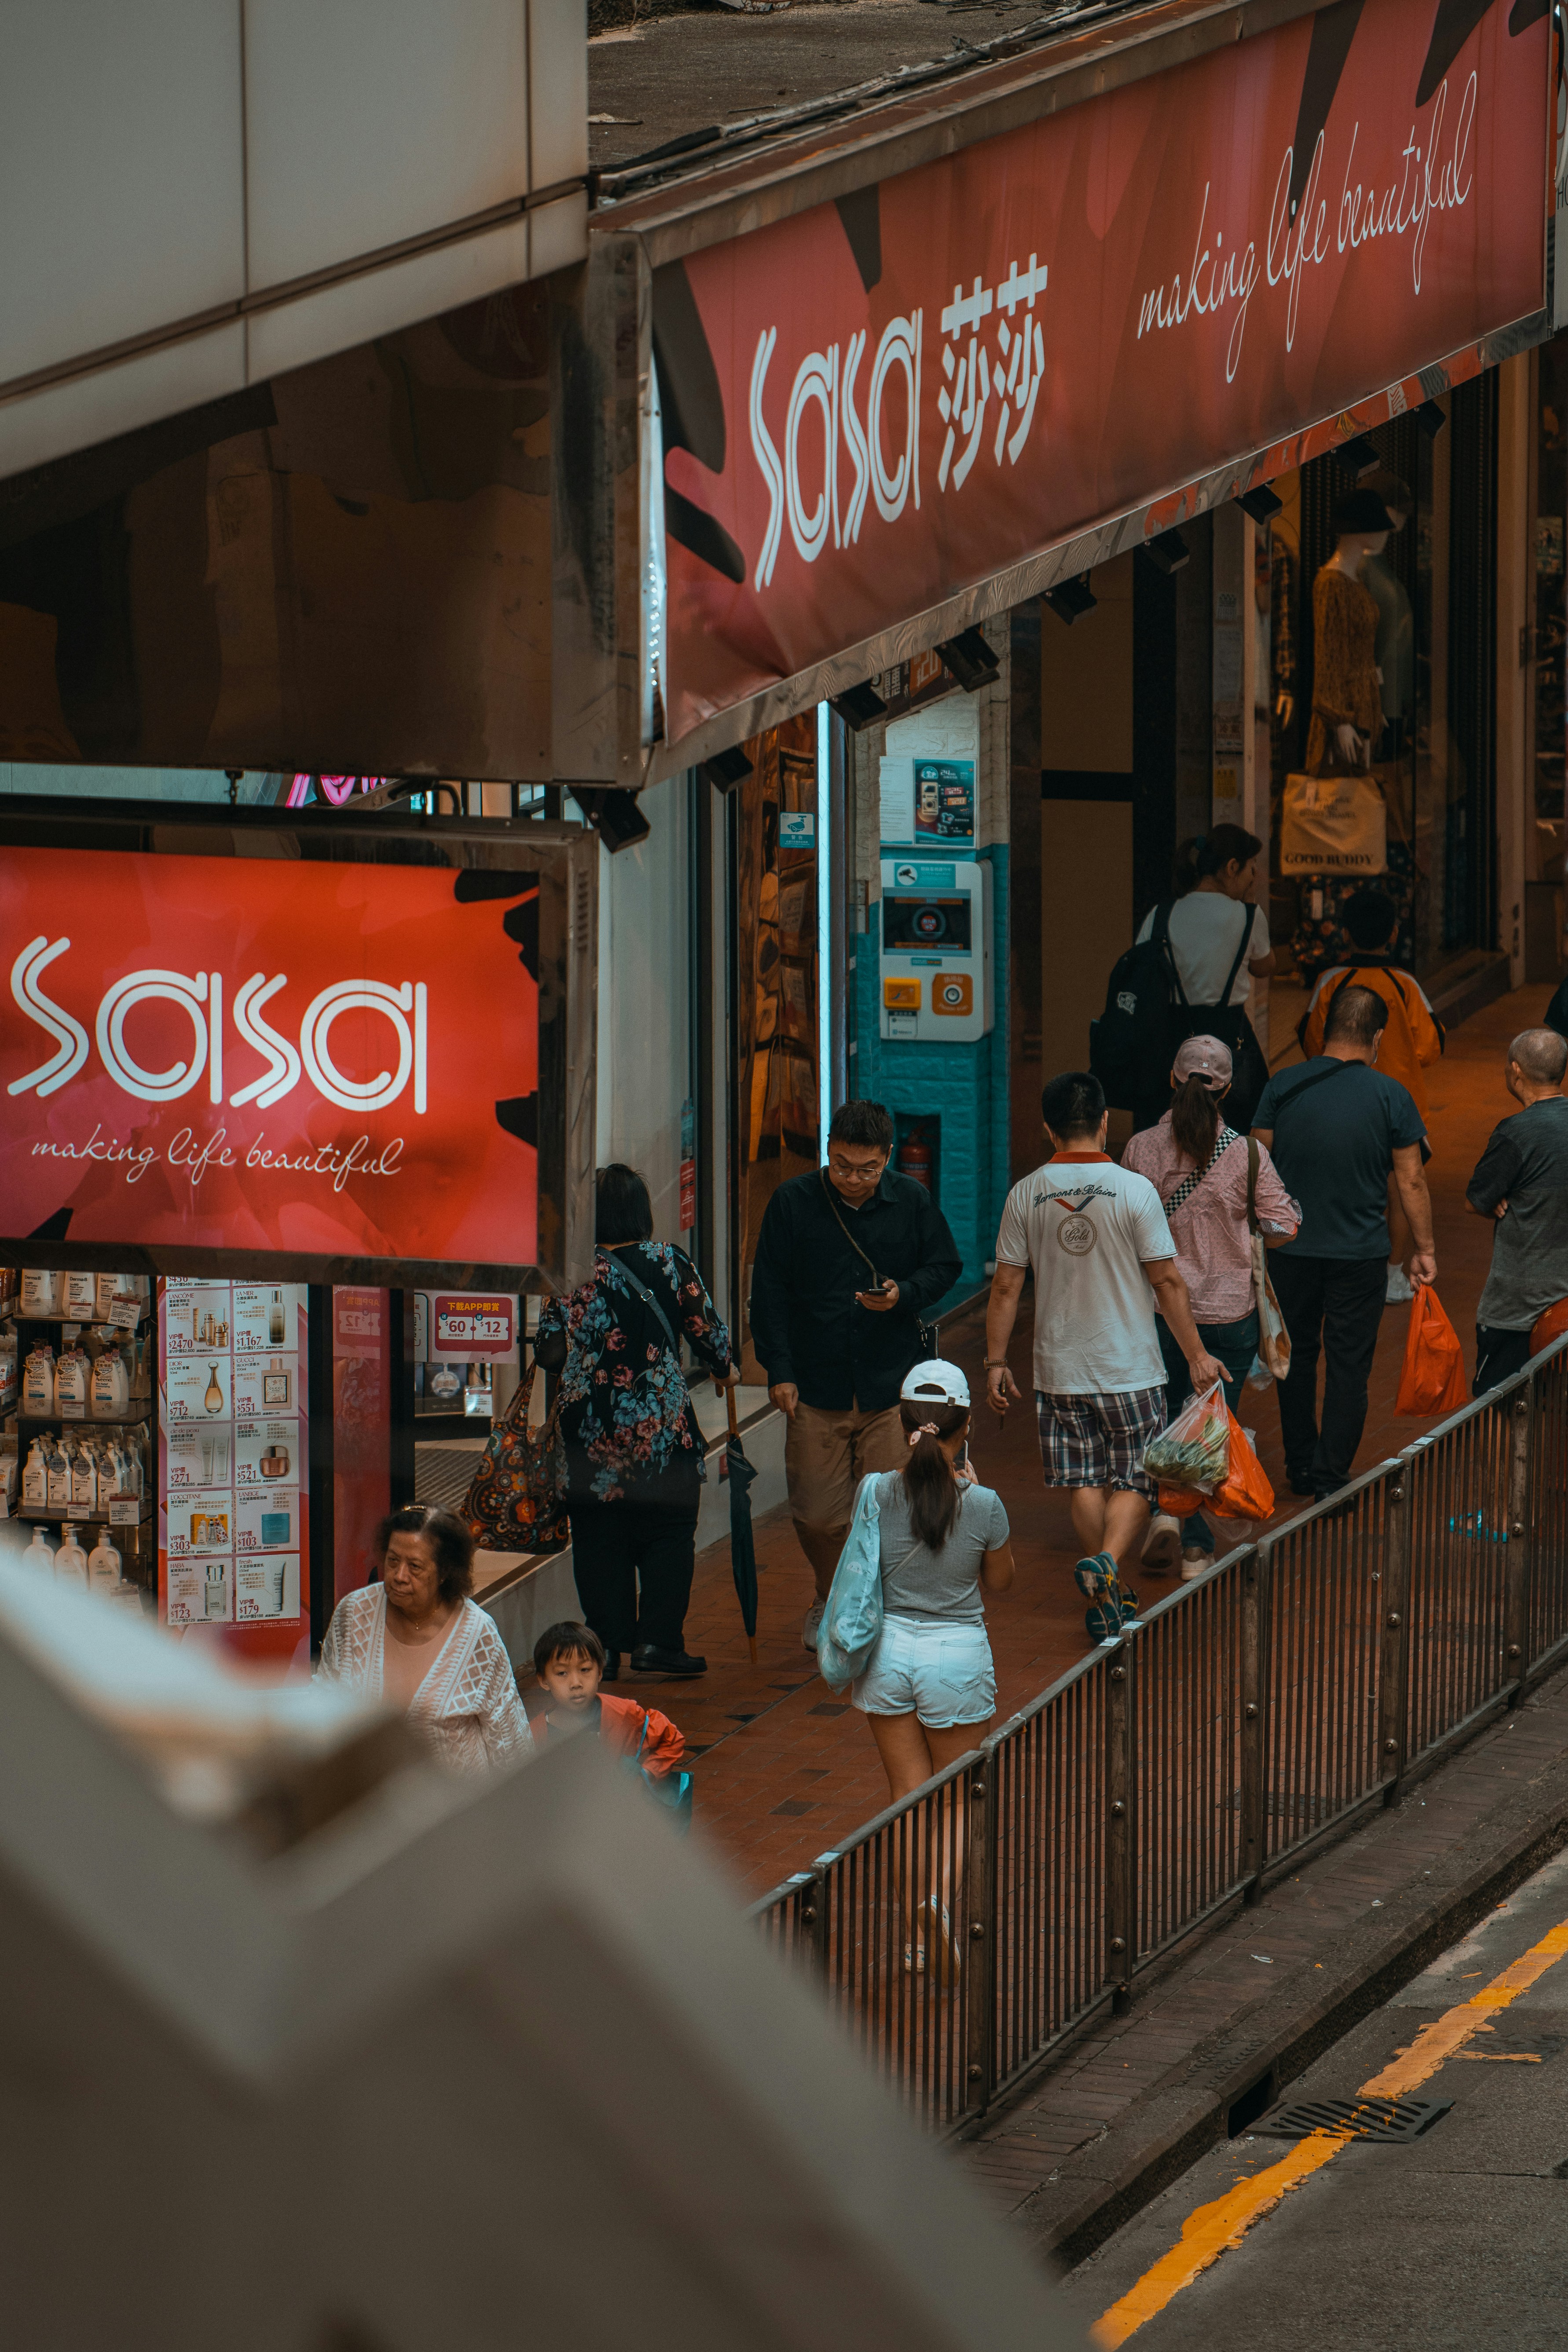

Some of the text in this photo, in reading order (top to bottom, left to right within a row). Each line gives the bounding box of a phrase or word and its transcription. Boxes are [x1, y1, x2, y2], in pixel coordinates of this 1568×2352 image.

[1137, 69, 1477, 383] making life beautiful
[937, 252, 1049, 493] 莎莎
[1285, 854, 1373, 866] GOOD BUDDY
[32, 1123, 405, 1193] making life beautiful
[1034, 1188, 1073, 1208] Harmont
[1082, 1184, 1117, 1198] Blaine
[1065, 1227, 1090, 1242] Gold
[447, 1302, 500, 1311] 下載APP即賞
[445, 1320, 466, 1333] $60
[480, 1321, 501, 1333] $12
[237, 1337, 262, 1348] $1,167
[170, 1406, 188, 1416] $712
[237, 1403, 255, 1413] $551
[171, 1473, 189, 1483] $271
[237, 1470, 256, 1480] $521
[170, 1541, 190, 1550] $303
[238, 1537, 256, 1547] $103
[171, 1609, 190, 1619] $123
[240, 1605, 259, 1614] $179
